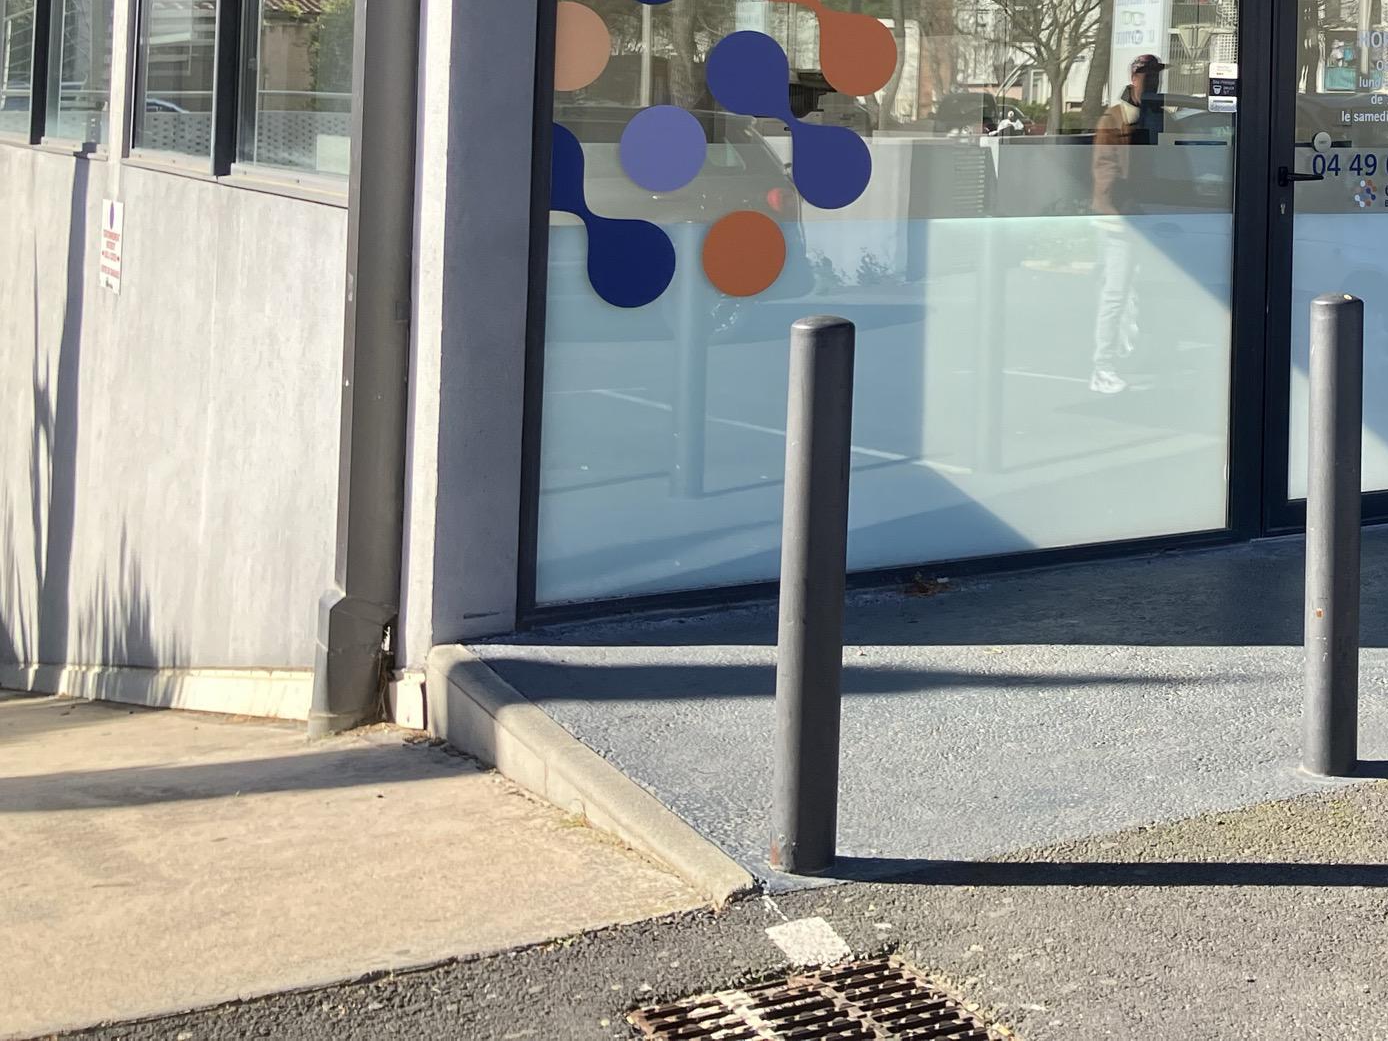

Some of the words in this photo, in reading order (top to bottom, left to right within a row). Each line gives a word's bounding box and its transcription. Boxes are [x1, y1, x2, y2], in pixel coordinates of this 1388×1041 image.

[1370, 94, 1383, 105] de
[1341, 110, 1351, 122] le
[1353, 111, 1388, 122] samedi
[1312, 154, 1341, 176] 04
[1348, 154, 1377, 177] 49
